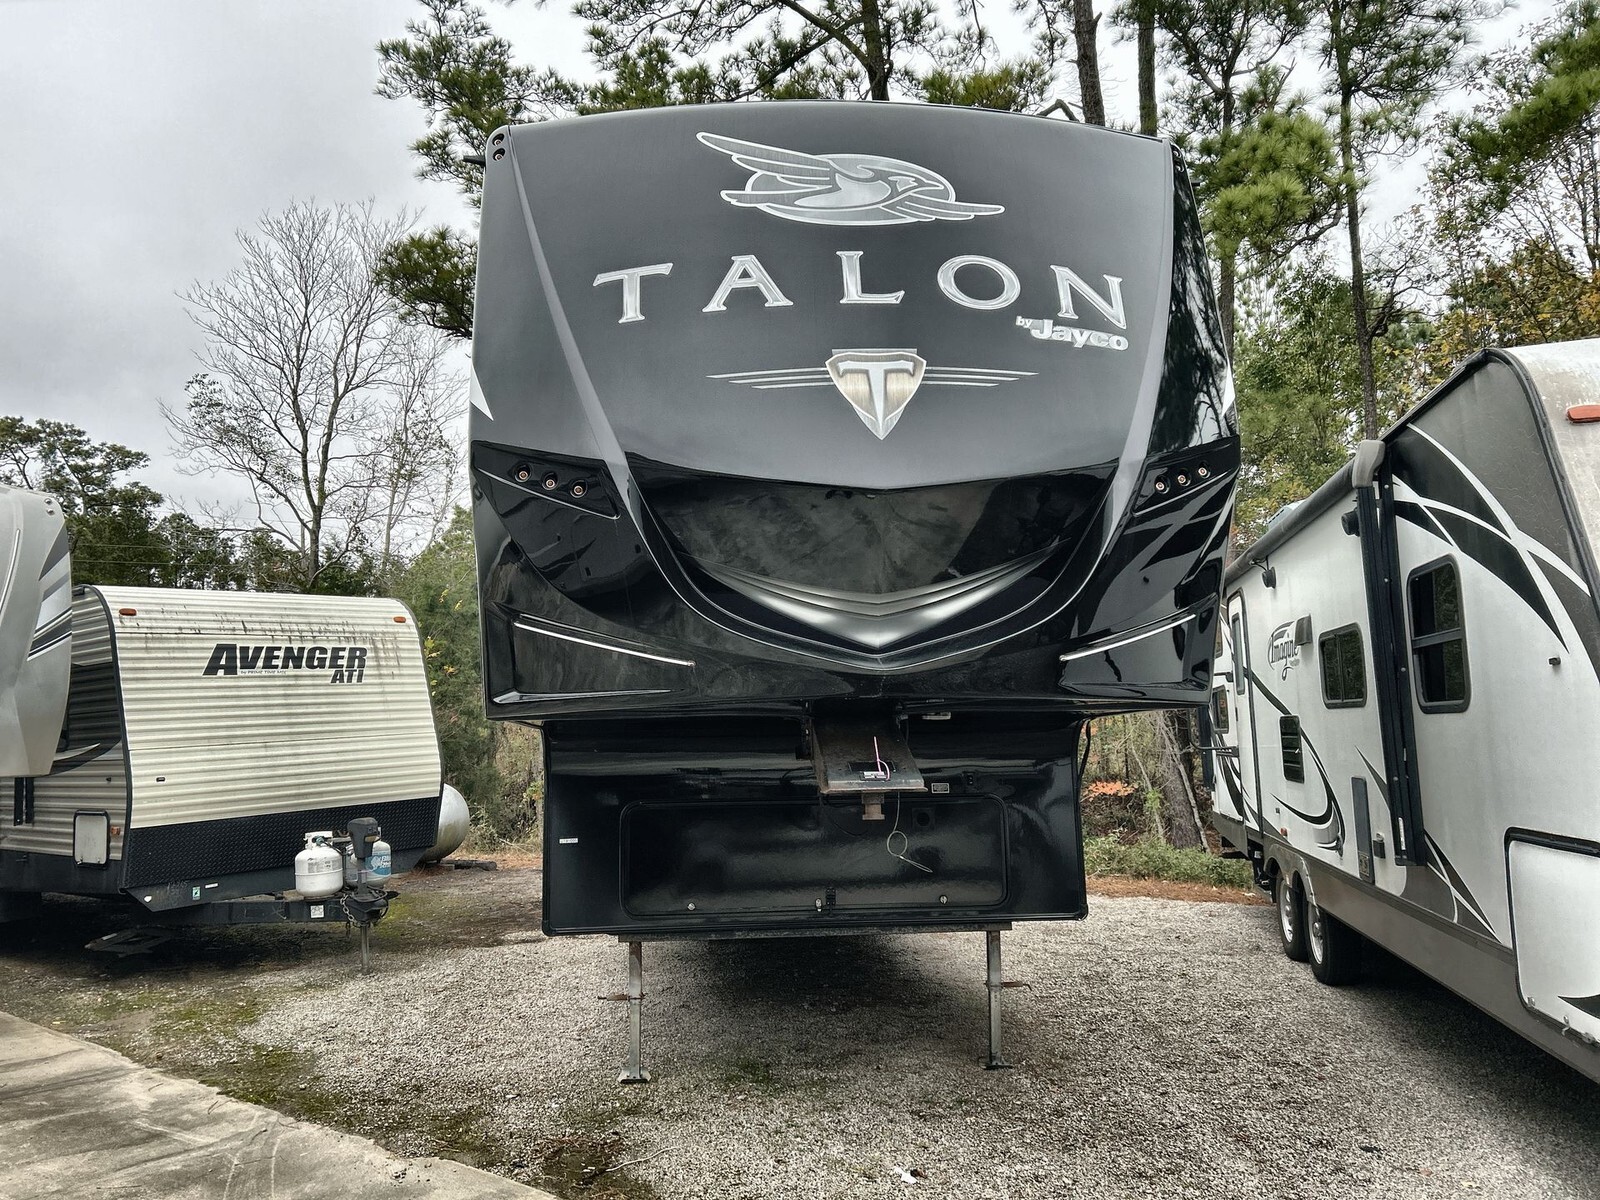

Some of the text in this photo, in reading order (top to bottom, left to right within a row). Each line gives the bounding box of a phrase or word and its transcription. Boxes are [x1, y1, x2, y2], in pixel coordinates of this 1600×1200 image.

[593, 251, 1127, 329] TALON
[1015, 315, 1129, 351] by Jayco
[837, 359, 915, 431] T
[202, 644, 367, 676] AVENGER
[330, 669, 364, 684] ATI
